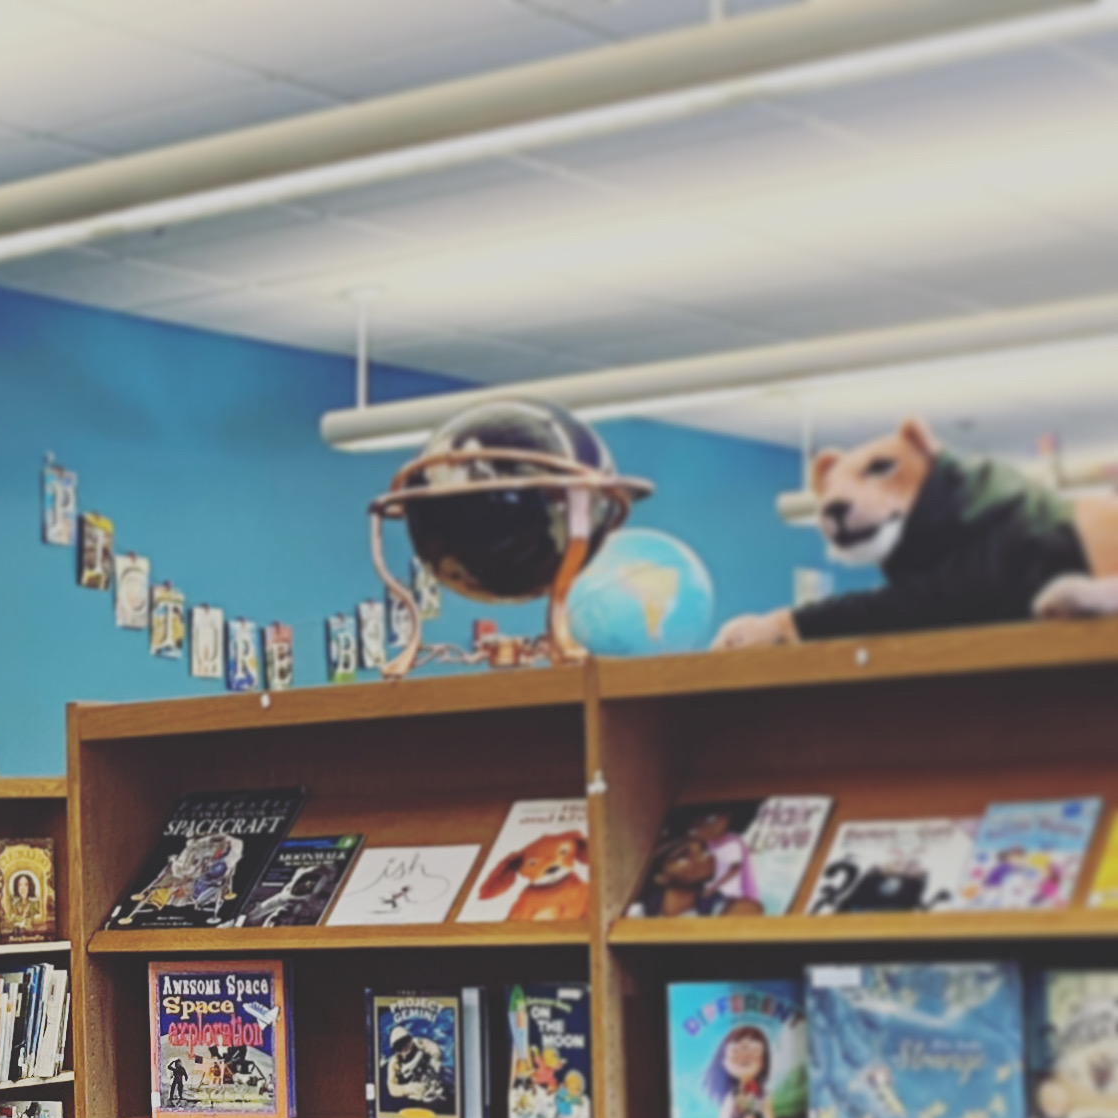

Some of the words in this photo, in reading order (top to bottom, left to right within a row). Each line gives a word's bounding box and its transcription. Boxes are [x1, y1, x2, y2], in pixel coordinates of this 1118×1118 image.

[163, 816, 285, 837] SPACECRAFT
[226, 975, 269, 1001] Space
[163, 997, 235, 1019] Space
[390, 997, 445, 1013] PROJECT
[530, 1005, 551, 1020] ON
[168, 1012, 264, 1058] exploration
[542, 1034, 585, 1049] MOON
